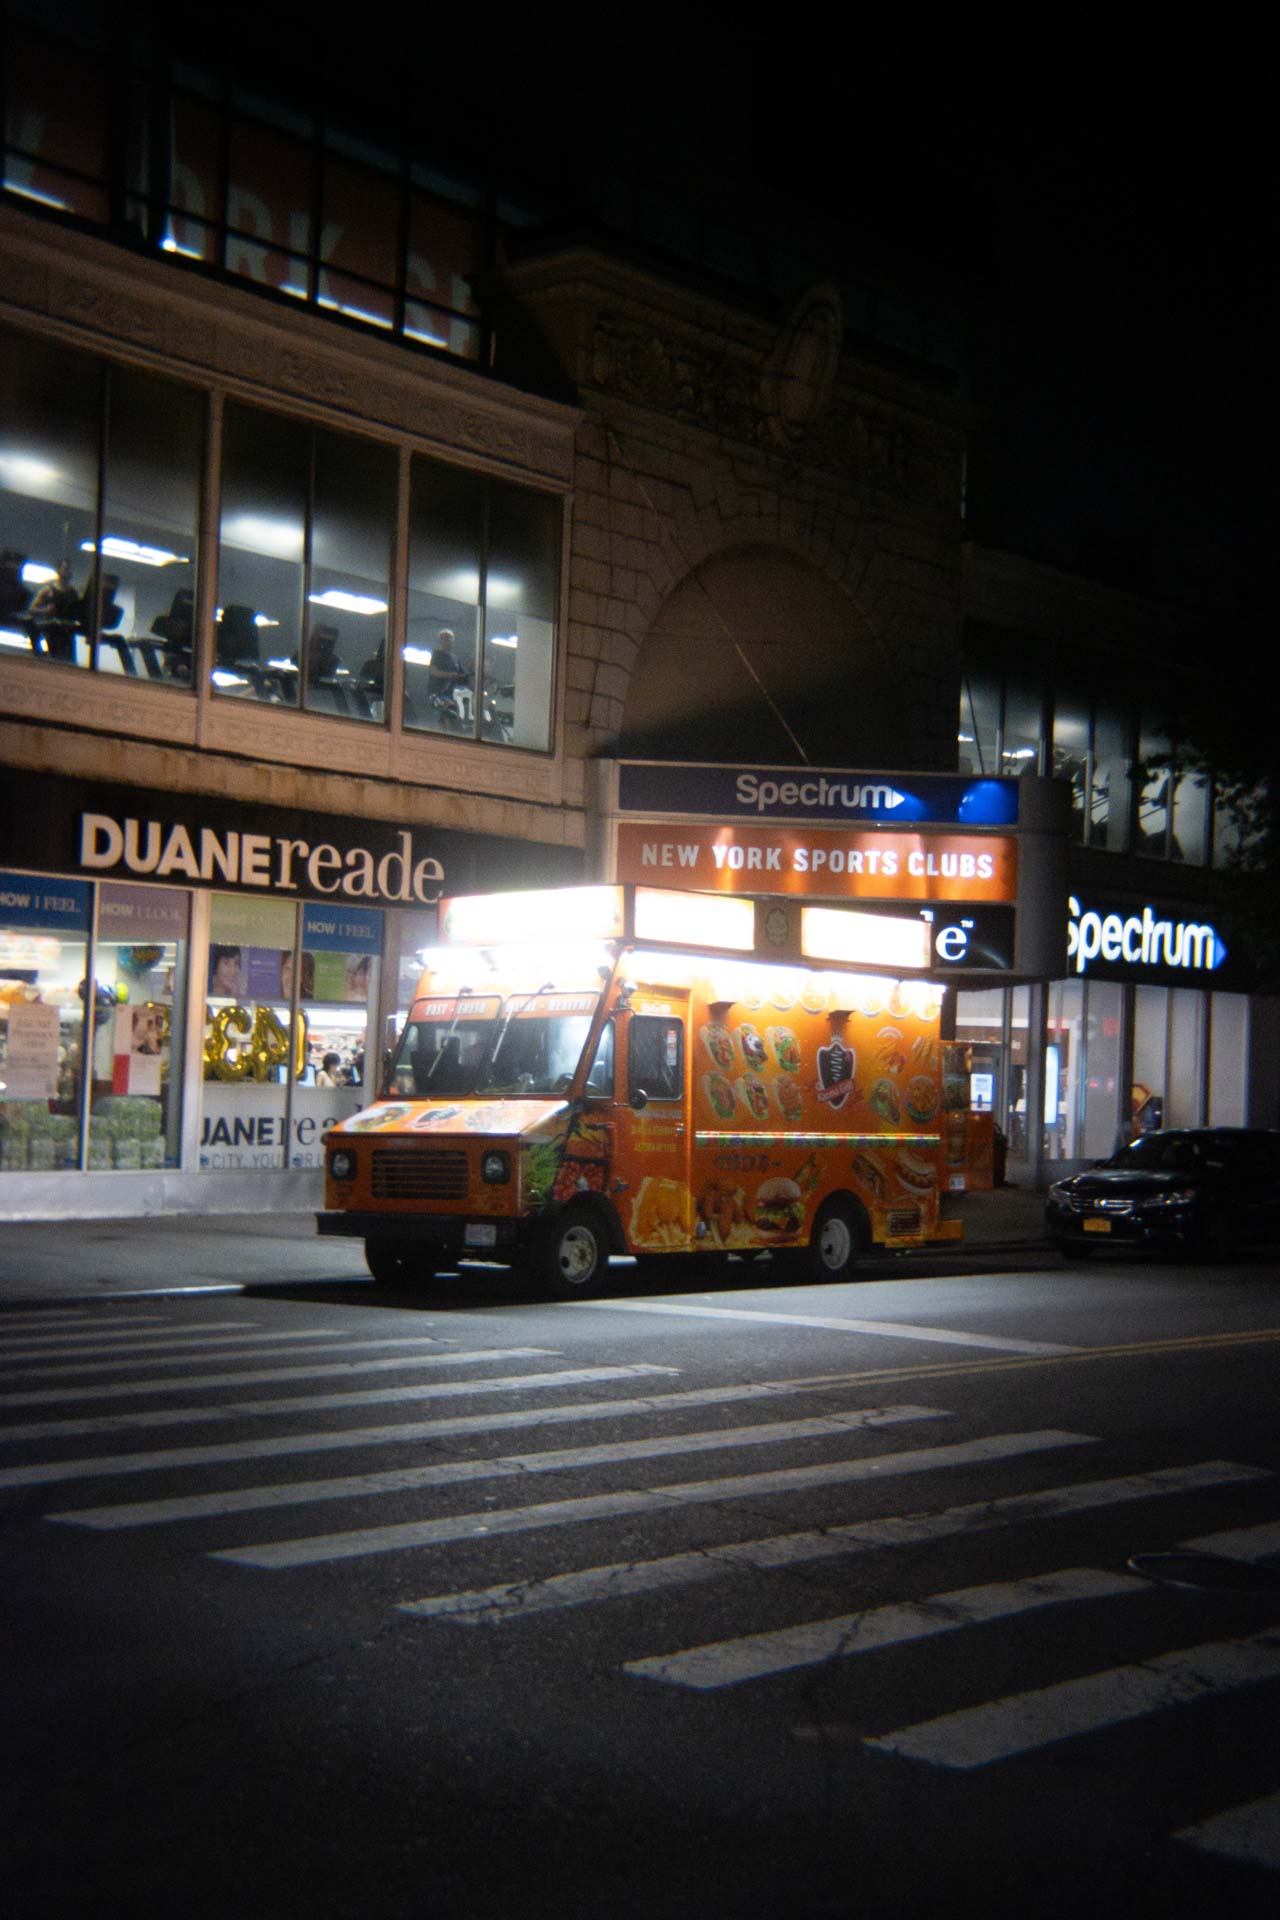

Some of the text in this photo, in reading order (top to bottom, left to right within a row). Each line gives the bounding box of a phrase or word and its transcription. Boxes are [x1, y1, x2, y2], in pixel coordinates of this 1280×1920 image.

[736, 775, 893, 811] Spectrum
[641, 843, 993, 879] NEW YORK SPORTS CLUBS
[307, 921, 336, 935] HOW
